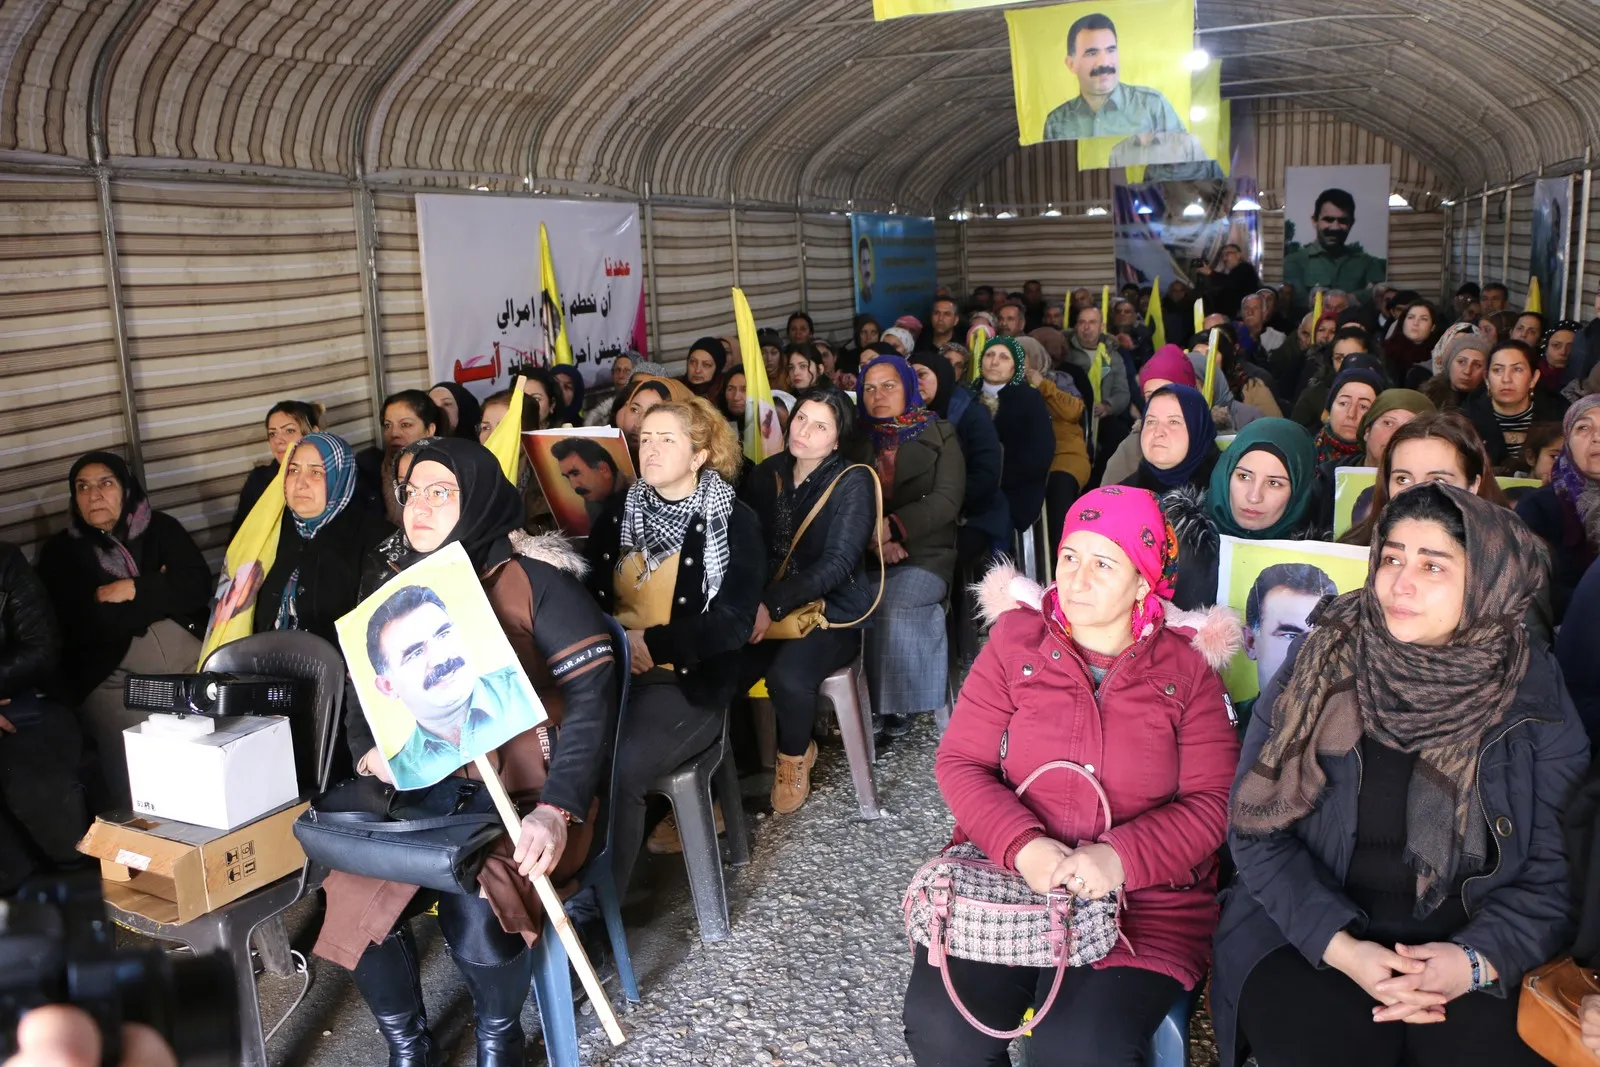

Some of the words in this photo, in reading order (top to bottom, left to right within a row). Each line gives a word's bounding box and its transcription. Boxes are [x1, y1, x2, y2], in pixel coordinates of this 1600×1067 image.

[604, 257, 631, 277] عهدنا
[497, 296, 535, 335] إمرالي
[570, 292, 597, 323] نحطم
[600, 284, 612, 318] أن
[594, 337, 622, 366] نعيش
[536, 726, 551, 760] QUEEN
